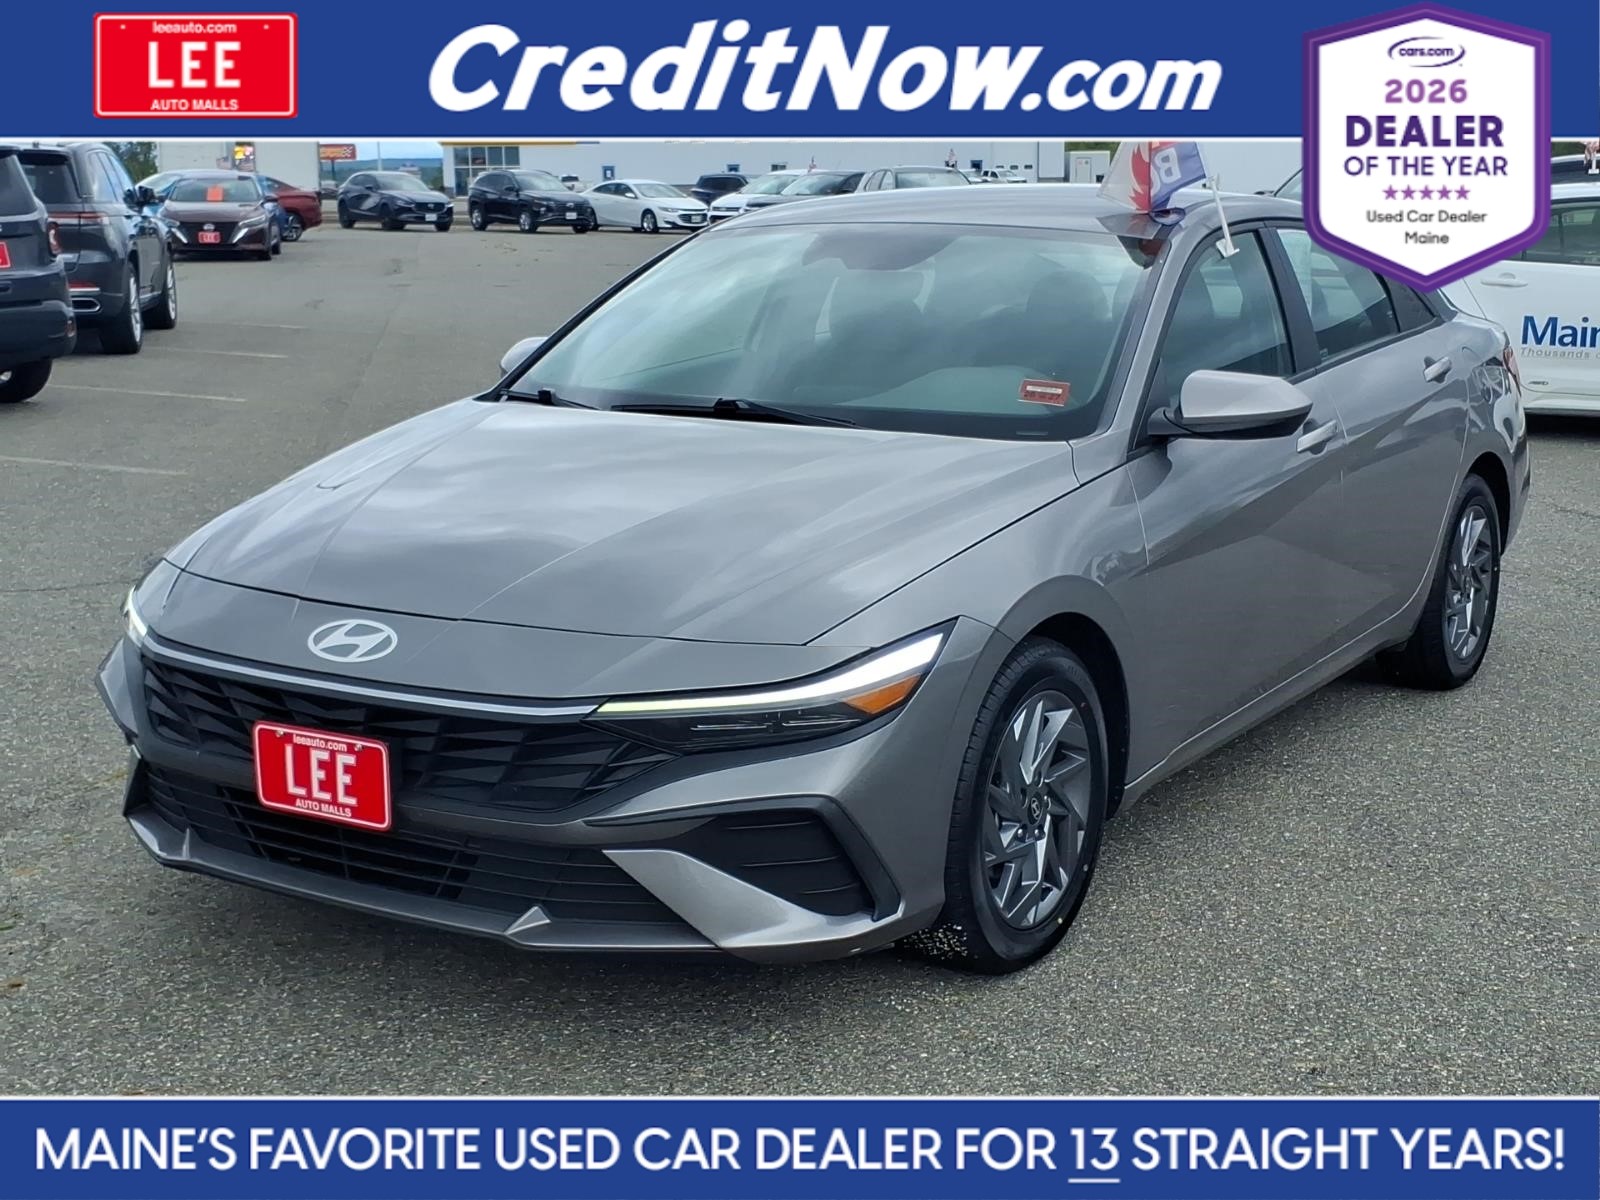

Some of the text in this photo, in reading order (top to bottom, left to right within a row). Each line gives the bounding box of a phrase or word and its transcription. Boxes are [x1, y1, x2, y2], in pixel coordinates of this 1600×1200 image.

[1521, 347, 1591, 360] Thousands
[293, 733, 347, 752] leeauto.com
[284, 743, 358, 807] LEE
[295, 799, 352, 818] AUTO MALLS
